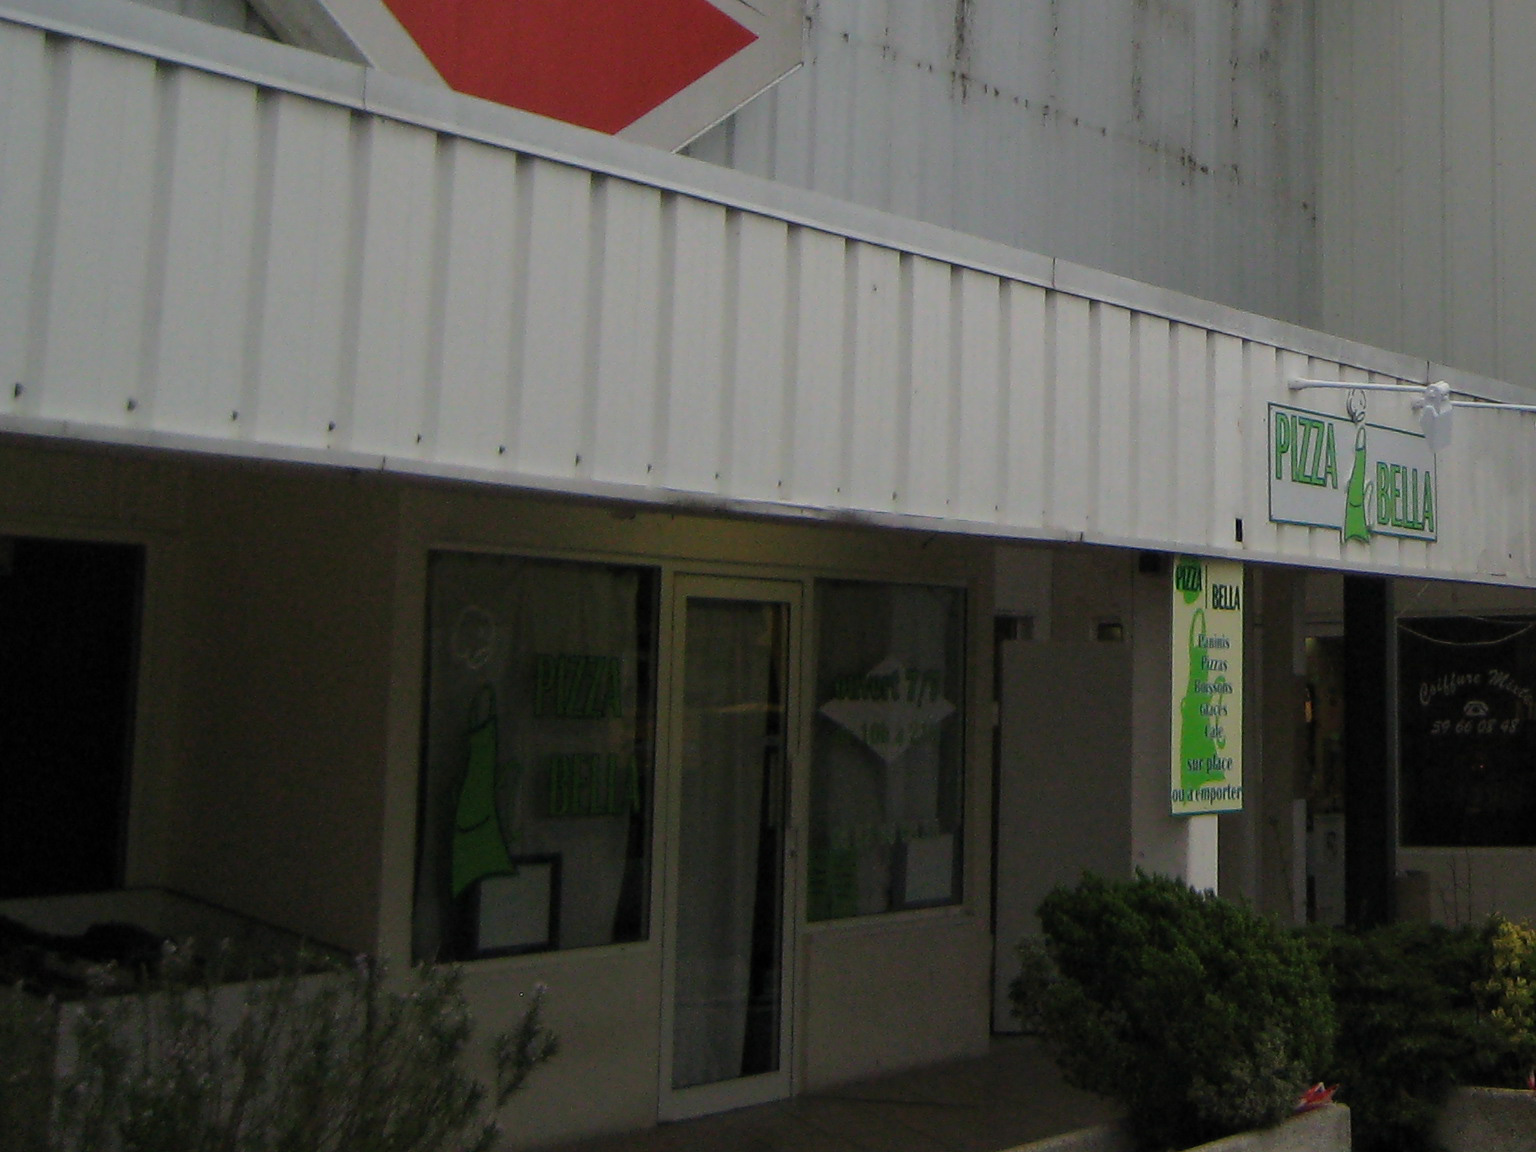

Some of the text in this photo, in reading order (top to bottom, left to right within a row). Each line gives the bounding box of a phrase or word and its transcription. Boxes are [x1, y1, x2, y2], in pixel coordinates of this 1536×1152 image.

[1275, 412, 1434, 533] PIZZA BELLA
[1176, 565, 1240, 610] PIZZA BELLA
[533, 653, 623, 719] PIZZA
[1419, 671, 1482, 706] Coiffure
[548, 752, 642, 817] BELLA
[1187, 754, 1233, 774] sur place
[1172, 788, 1185, 802] ou
[1195, 784, 1242, 805] emporter
